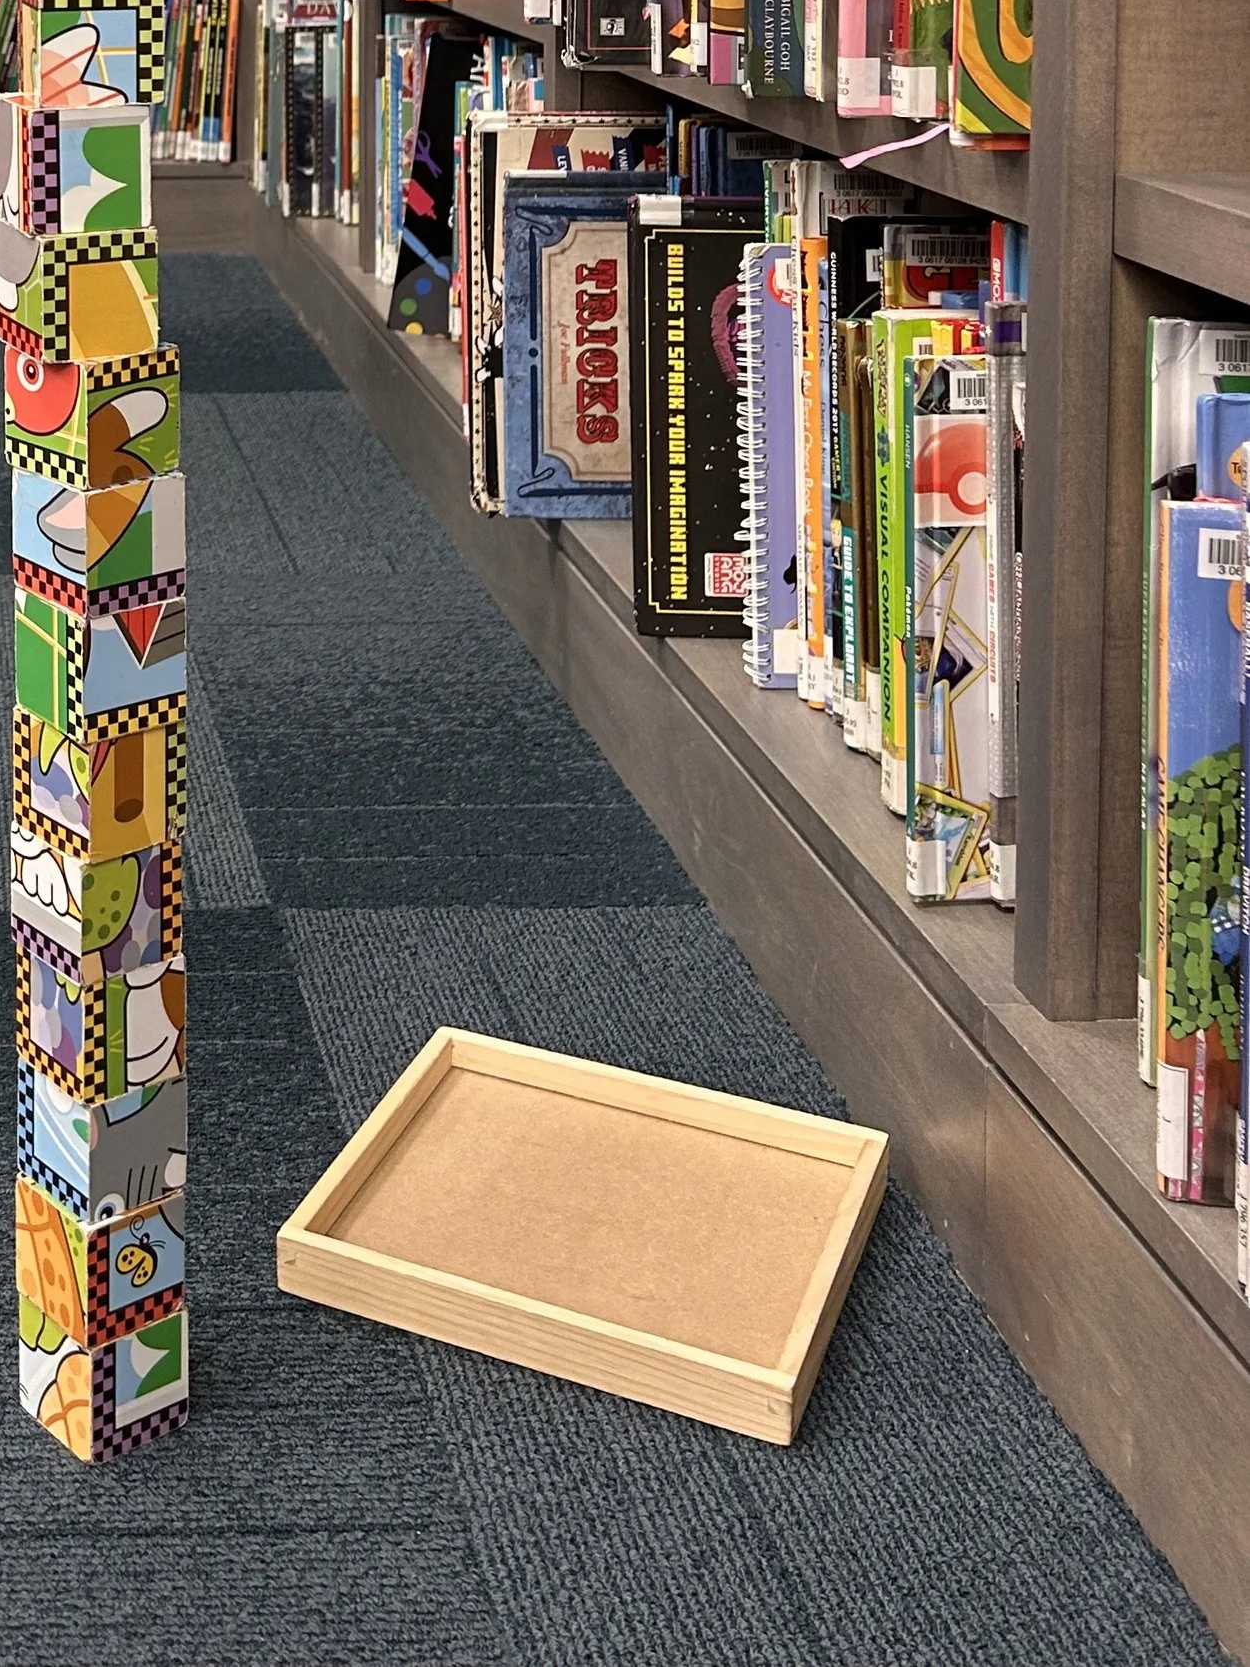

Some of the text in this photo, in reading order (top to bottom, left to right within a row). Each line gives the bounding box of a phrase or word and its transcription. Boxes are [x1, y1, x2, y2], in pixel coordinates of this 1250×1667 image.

[779, 36, 791, 73] GOH
[791, 235, 799, 285] Chess
[575, 259, 620, 444] TRICKS
[818, 300, 828, 368] Chess
[830, 311, 838, 347] WORLD
[667, 243, 688, 601] BUILDS TO SPARK YOUR IMAGINATION
[801, 370, 814, 516] My First Book
[831, 406, 839, 434] 2017
[842, 535, 853, 603] GUIDE TO
[878, 474, 892, 724] VISUAL COMPANION
[904, 585, 912, 639] Pokémon
[988, 630, 996, 683] CIRCUITS
[1139, 570, 1150, 831] SUPERSTARS NEYMAR
